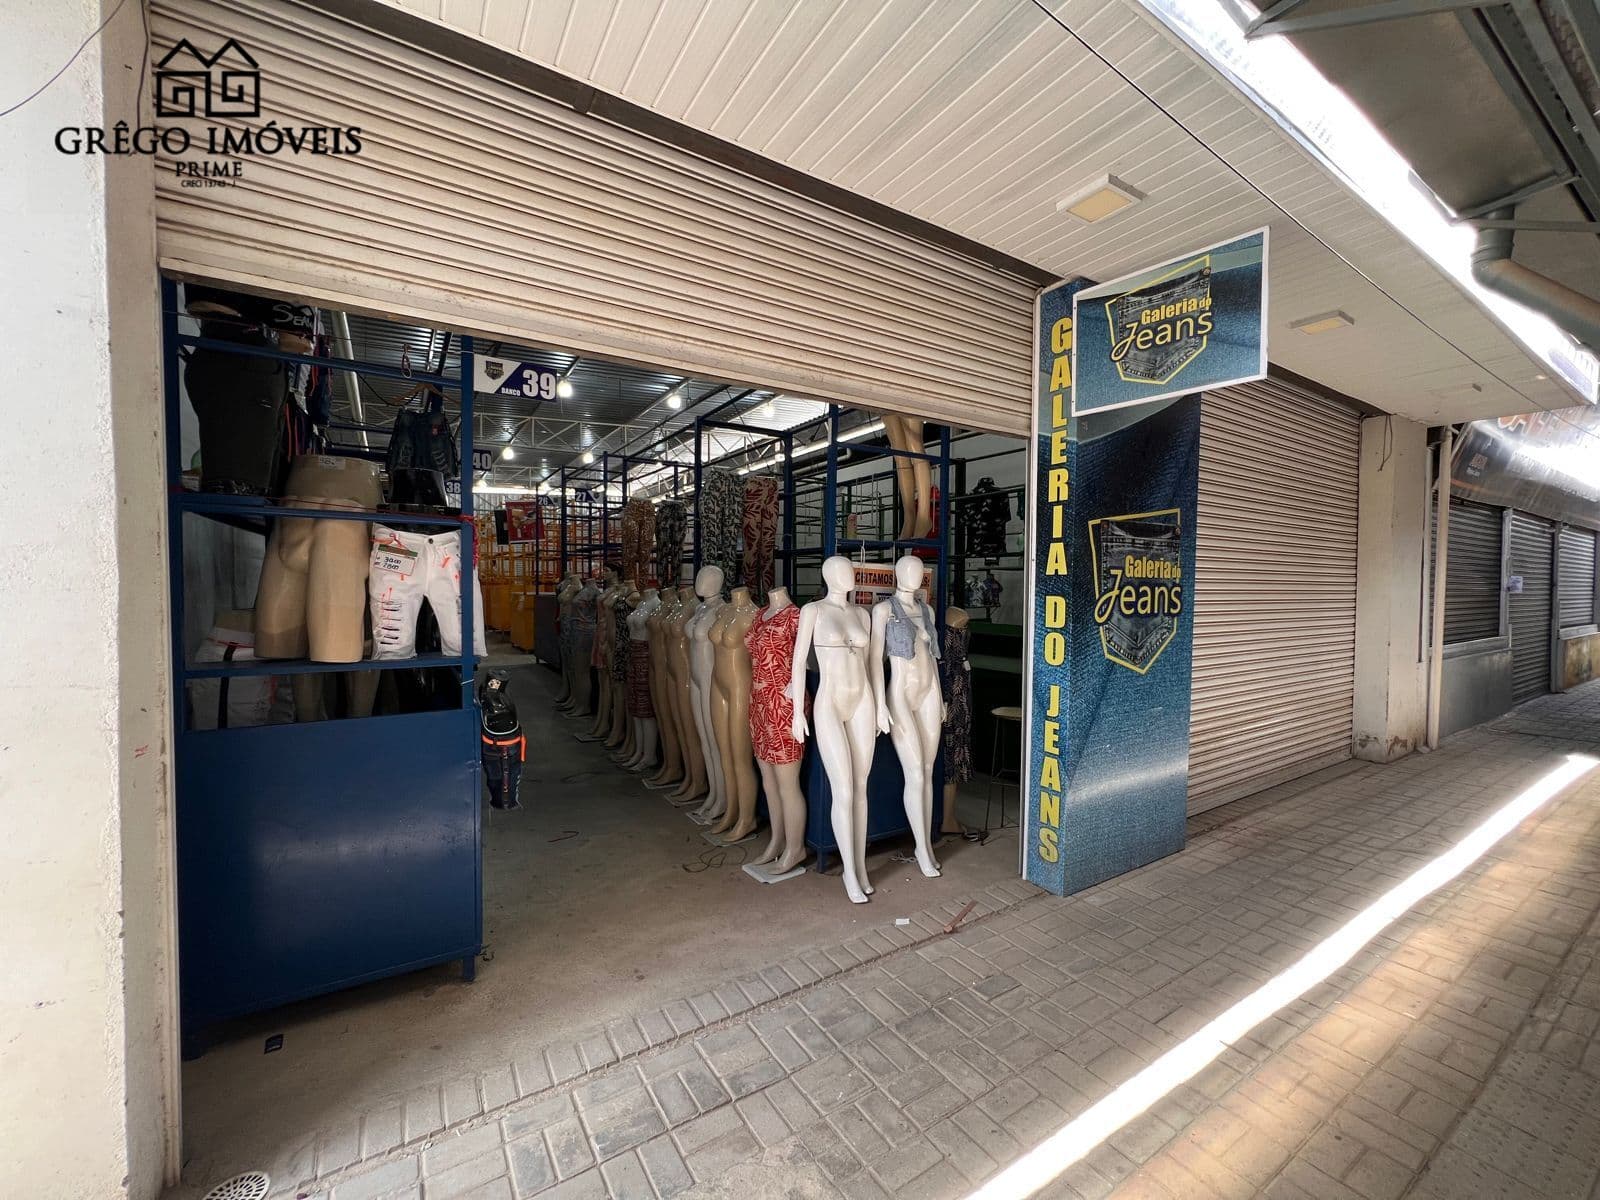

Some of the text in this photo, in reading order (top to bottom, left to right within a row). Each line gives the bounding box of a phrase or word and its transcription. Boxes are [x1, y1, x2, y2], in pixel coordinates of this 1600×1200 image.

[1141, 297, 1198, 325] Galeria
[1111, 312, 1213, 361] Jeans
[522, 369, 556, 400] 39
[472, 453, 492, 470] 40
[446, 481, 461, 494] 38
[855, 571, 894, 586] CEITAMOS
[1125, 554, 1171, 579] Galeria
[1039, 316, 1073, 863] GALERIA DO JEANS
[1094, 585, 1182, 624] Jeans
